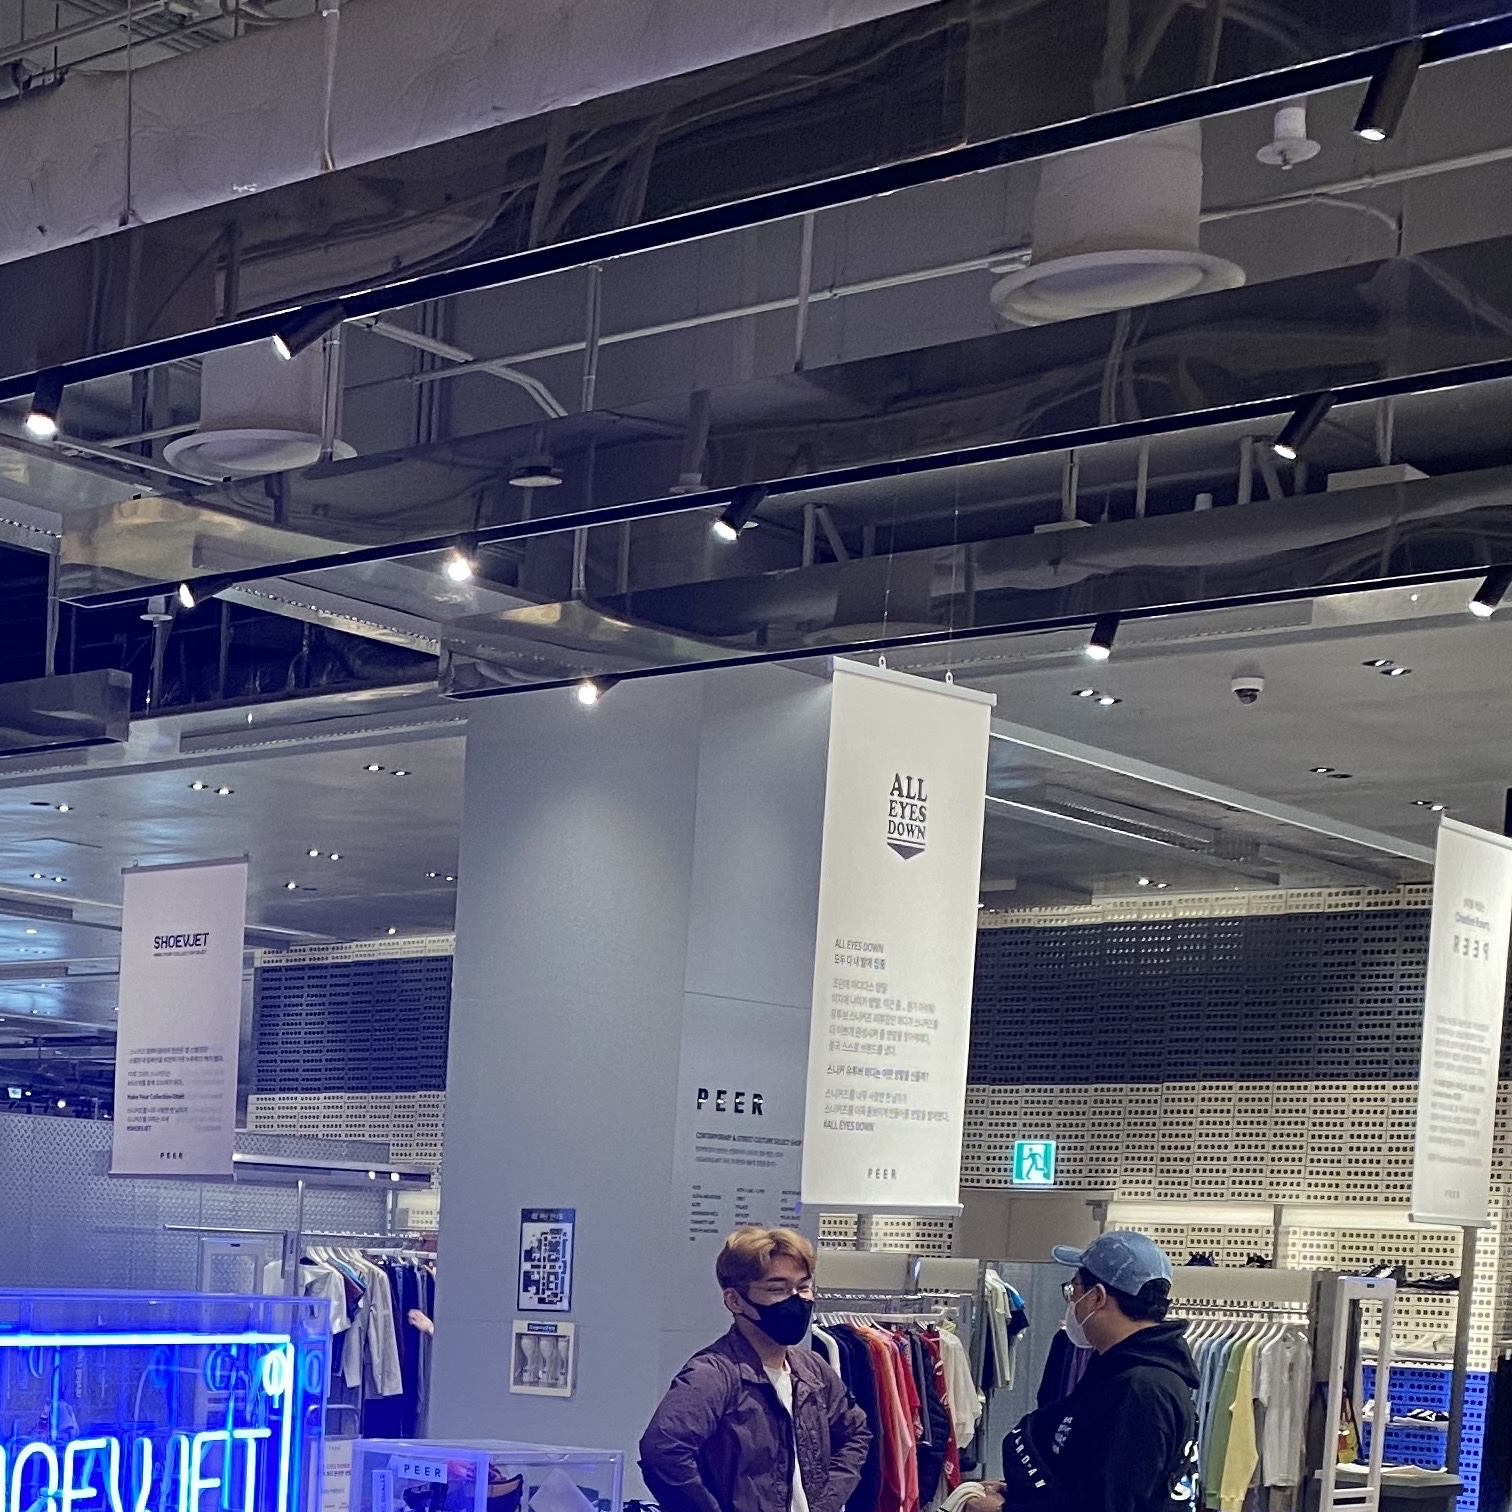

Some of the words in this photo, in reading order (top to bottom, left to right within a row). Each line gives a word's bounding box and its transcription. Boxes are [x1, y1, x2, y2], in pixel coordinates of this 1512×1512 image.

[889, 773, 928, 802] ALL
[888, 799, 927, 825] EYES
[887, 819, 927, 842] DOWN
[153, 931, 209, 950] SHOEVJET
[834, 938, 846, 950] ALL
[847, 940, 862, 952] EYES
[863, 941, 884, 954] DOWN
[697, 1087, 764, 1116] PEER
[160, 1151, 185, 1160] PEER
[868, 1167, 897, 1180] PEER
[404, 1463, 442, 1478] PEER
